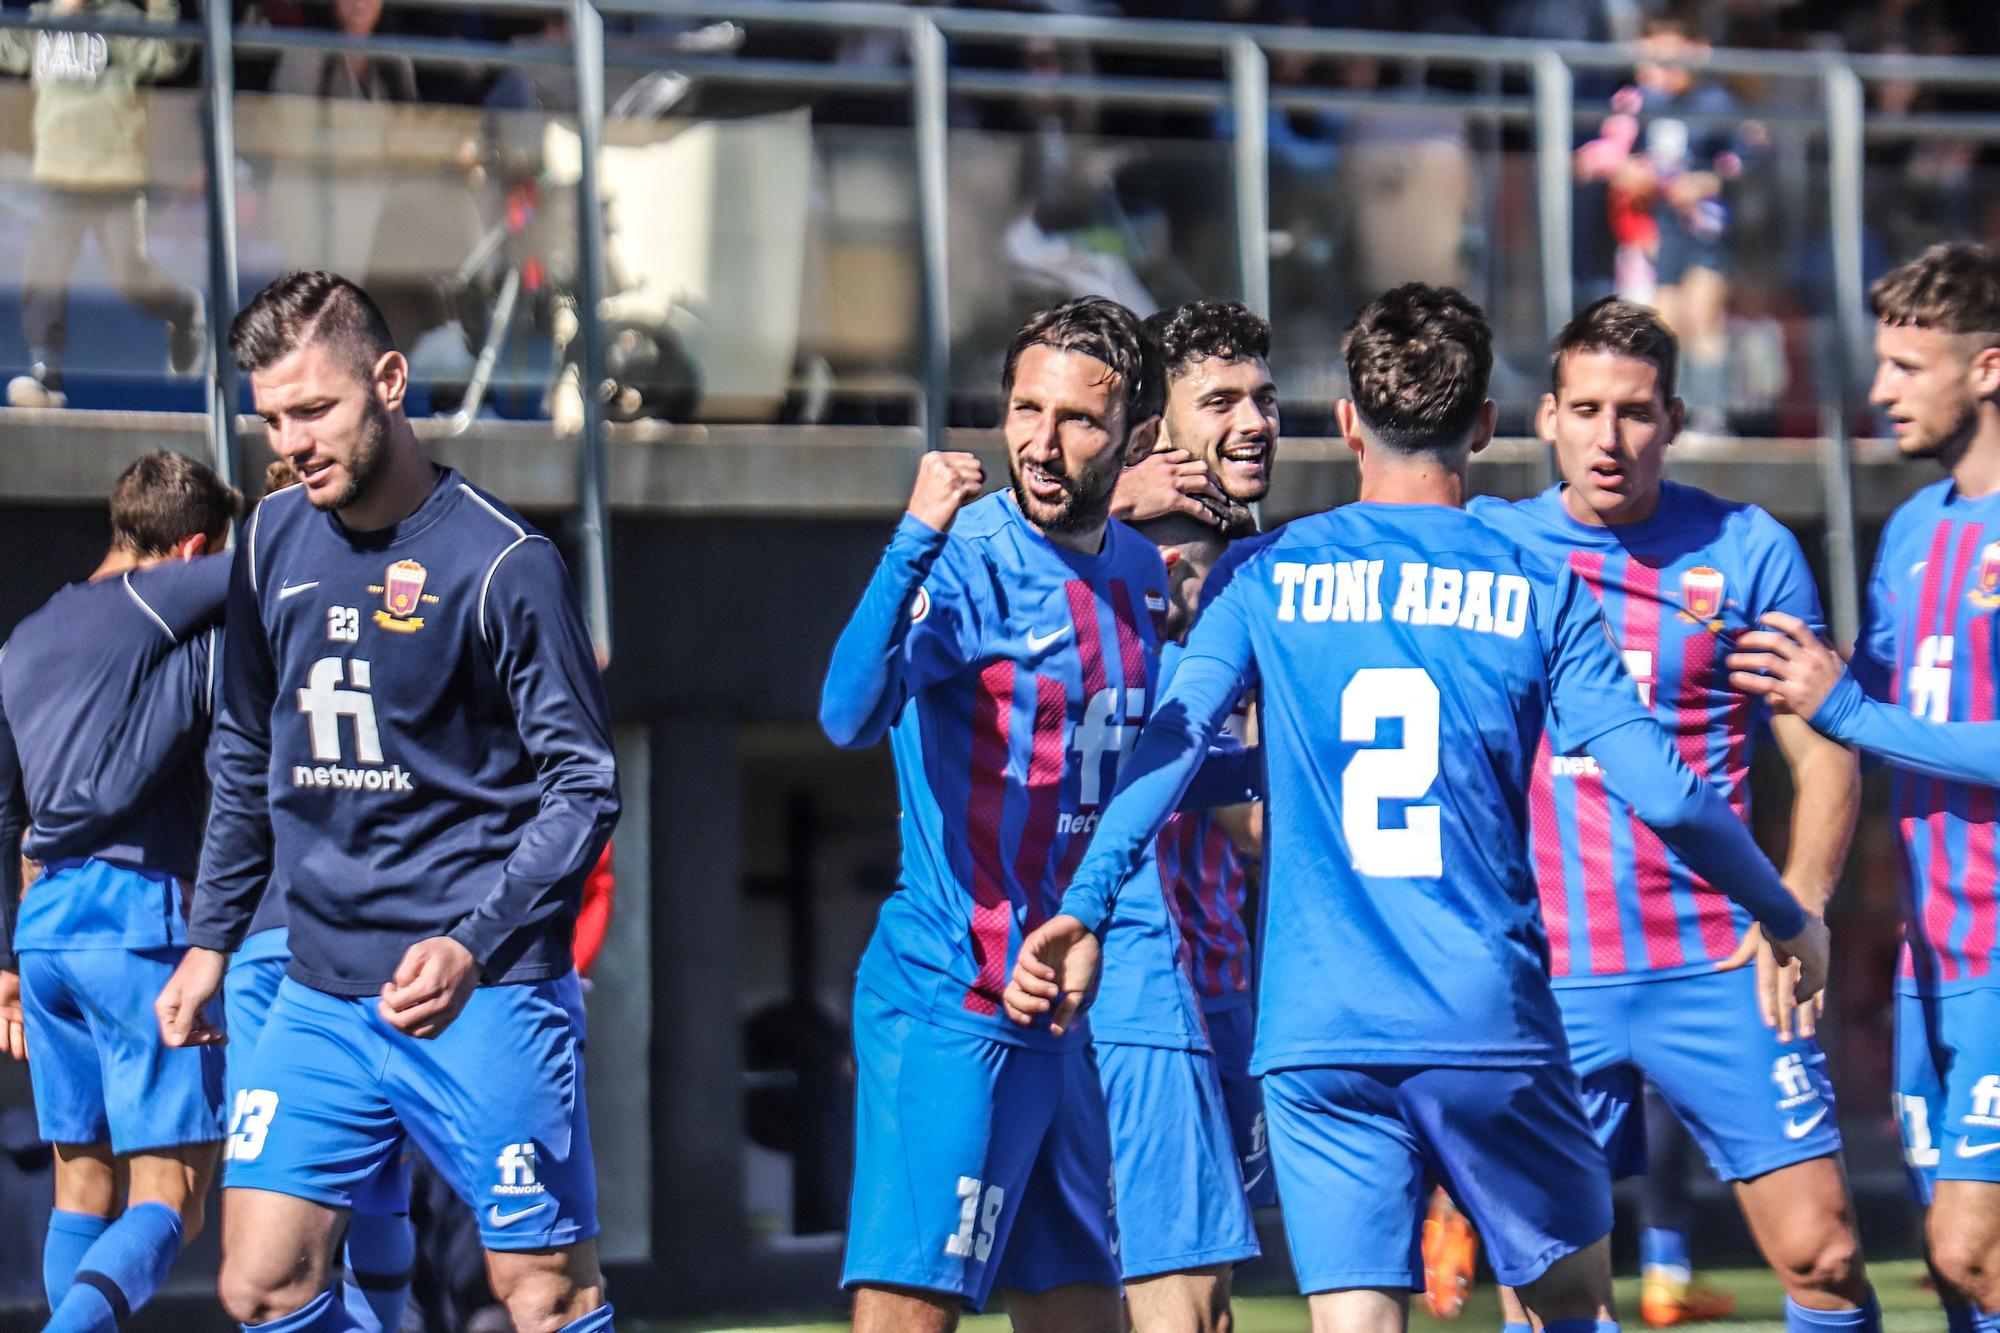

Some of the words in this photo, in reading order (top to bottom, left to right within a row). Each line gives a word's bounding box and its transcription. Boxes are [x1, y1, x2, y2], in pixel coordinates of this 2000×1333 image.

[1274, 560, 1385, 623] TONI
[1392, 563, 1531, 639] ABAD
[327, 606, 360, 643] 23
[297, 657, 384, 764] fi
[293, 764, 414, 791] network
[1340, 667, 1443, 878] 2
[1550, 755, 1600, 776] net
[496, 1142, 536, 1185] fi
[492, 1182, 545, 1195] network
[945, 1176, 1004, 1263] 19
